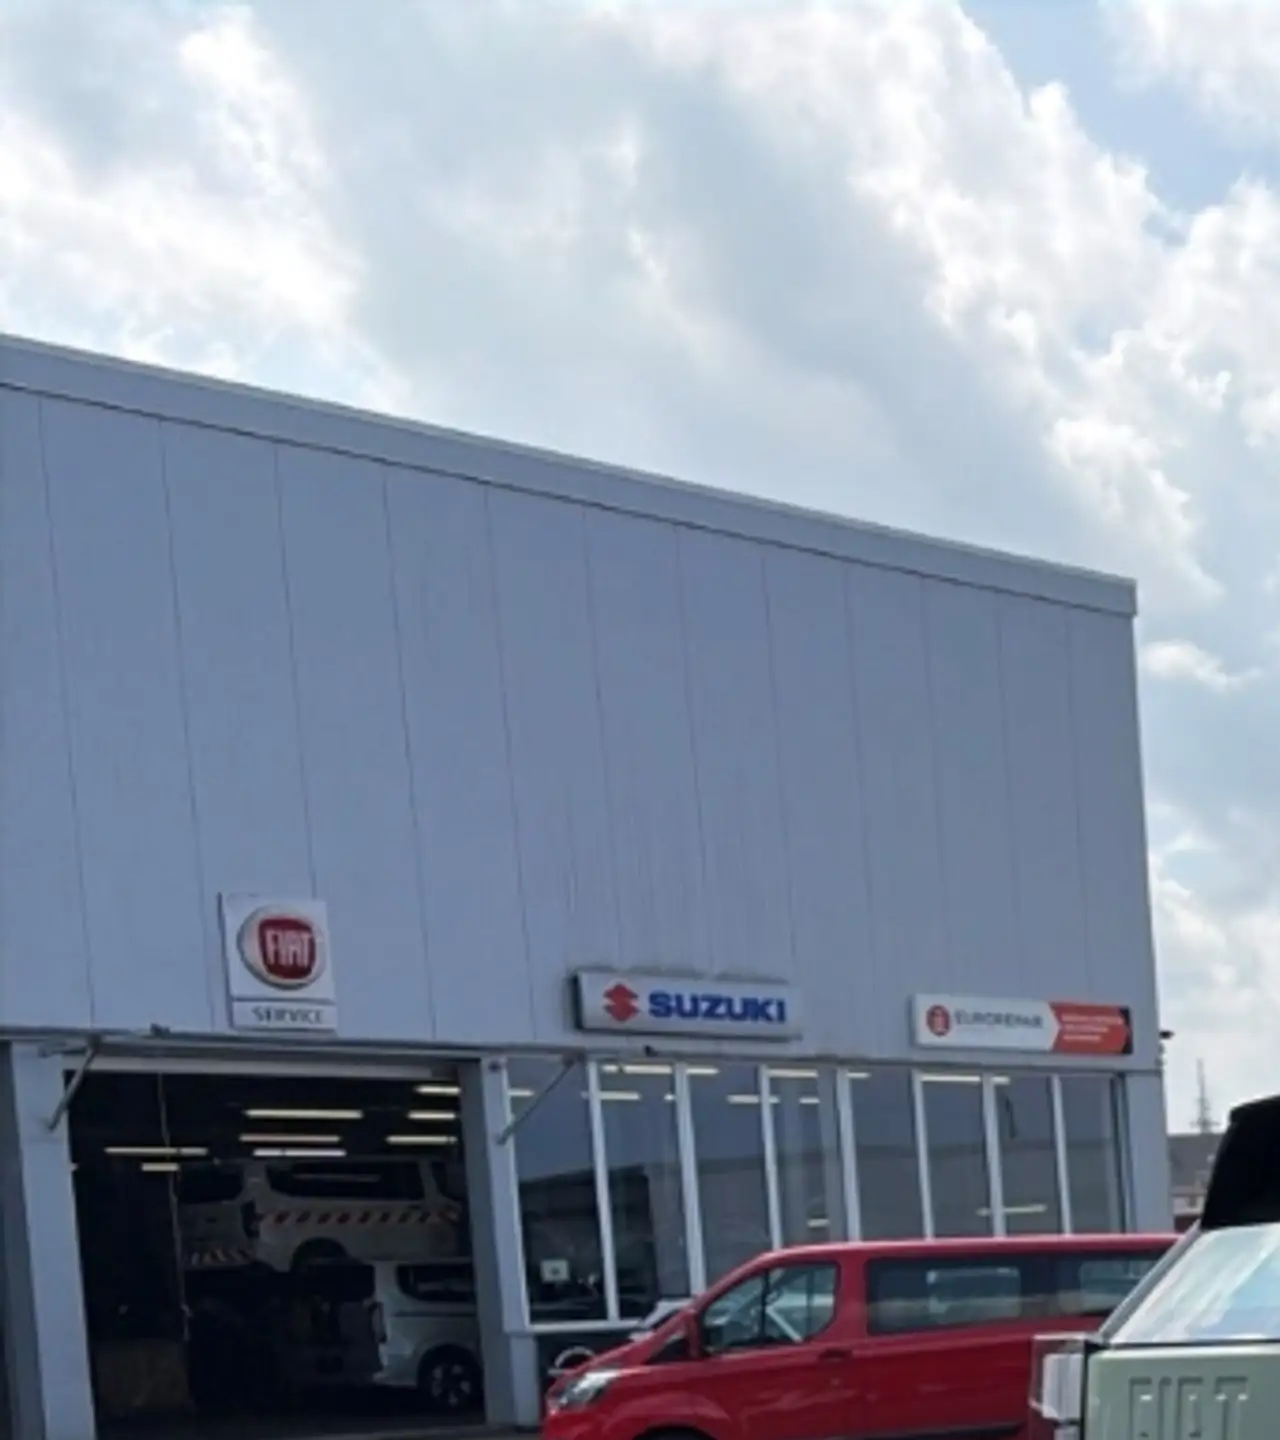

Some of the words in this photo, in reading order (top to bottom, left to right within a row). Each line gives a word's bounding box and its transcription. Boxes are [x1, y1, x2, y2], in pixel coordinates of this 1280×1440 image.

[265, 928, 312, 967] FIAT
[251, 1006, 324, 1024] SERVICE
[648, 991, 787, 1023] SUZUKI
